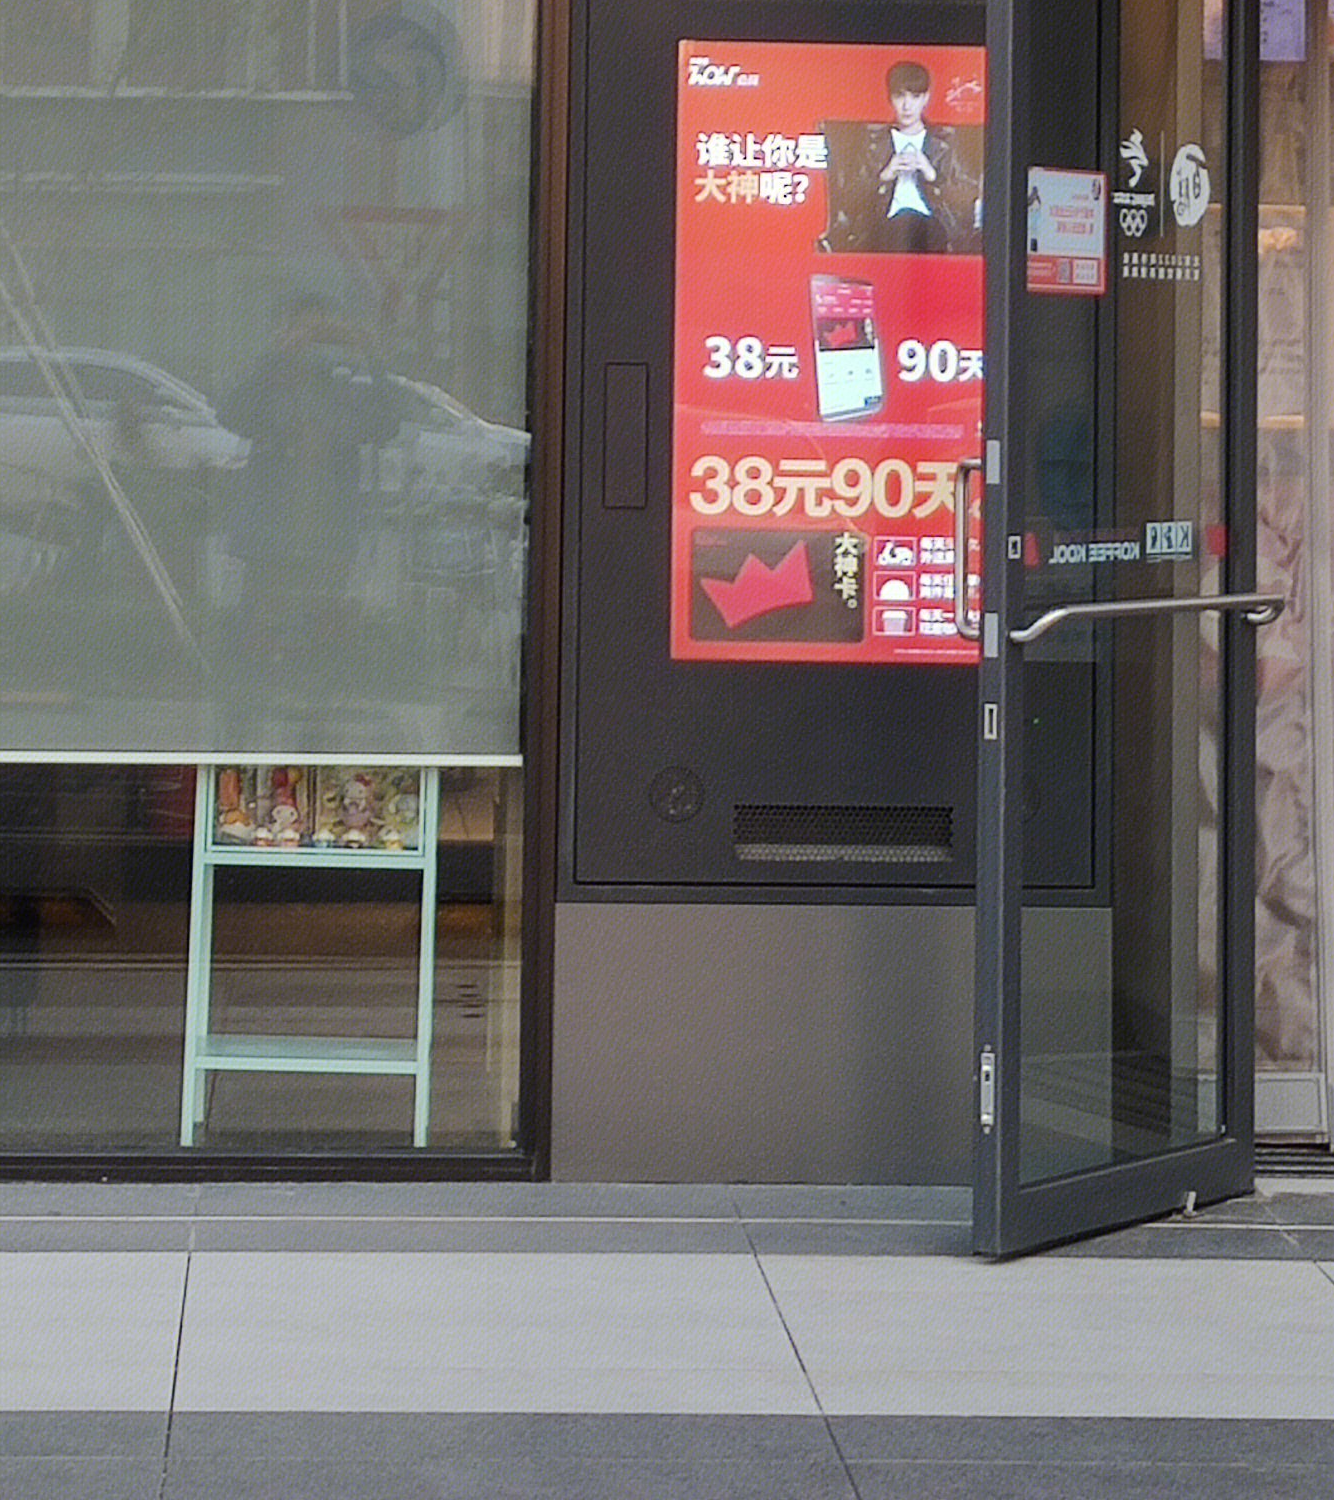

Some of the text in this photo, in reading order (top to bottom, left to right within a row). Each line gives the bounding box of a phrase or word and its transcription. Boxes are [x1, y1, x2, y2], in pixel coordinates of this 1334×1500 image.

[695, 132, 828, 169] 谁让你是
[694, 170, 810, 205] 大神呢?
[702, 336, 799, 380] 38元
[689, 455, 981, 518] 38元90天
